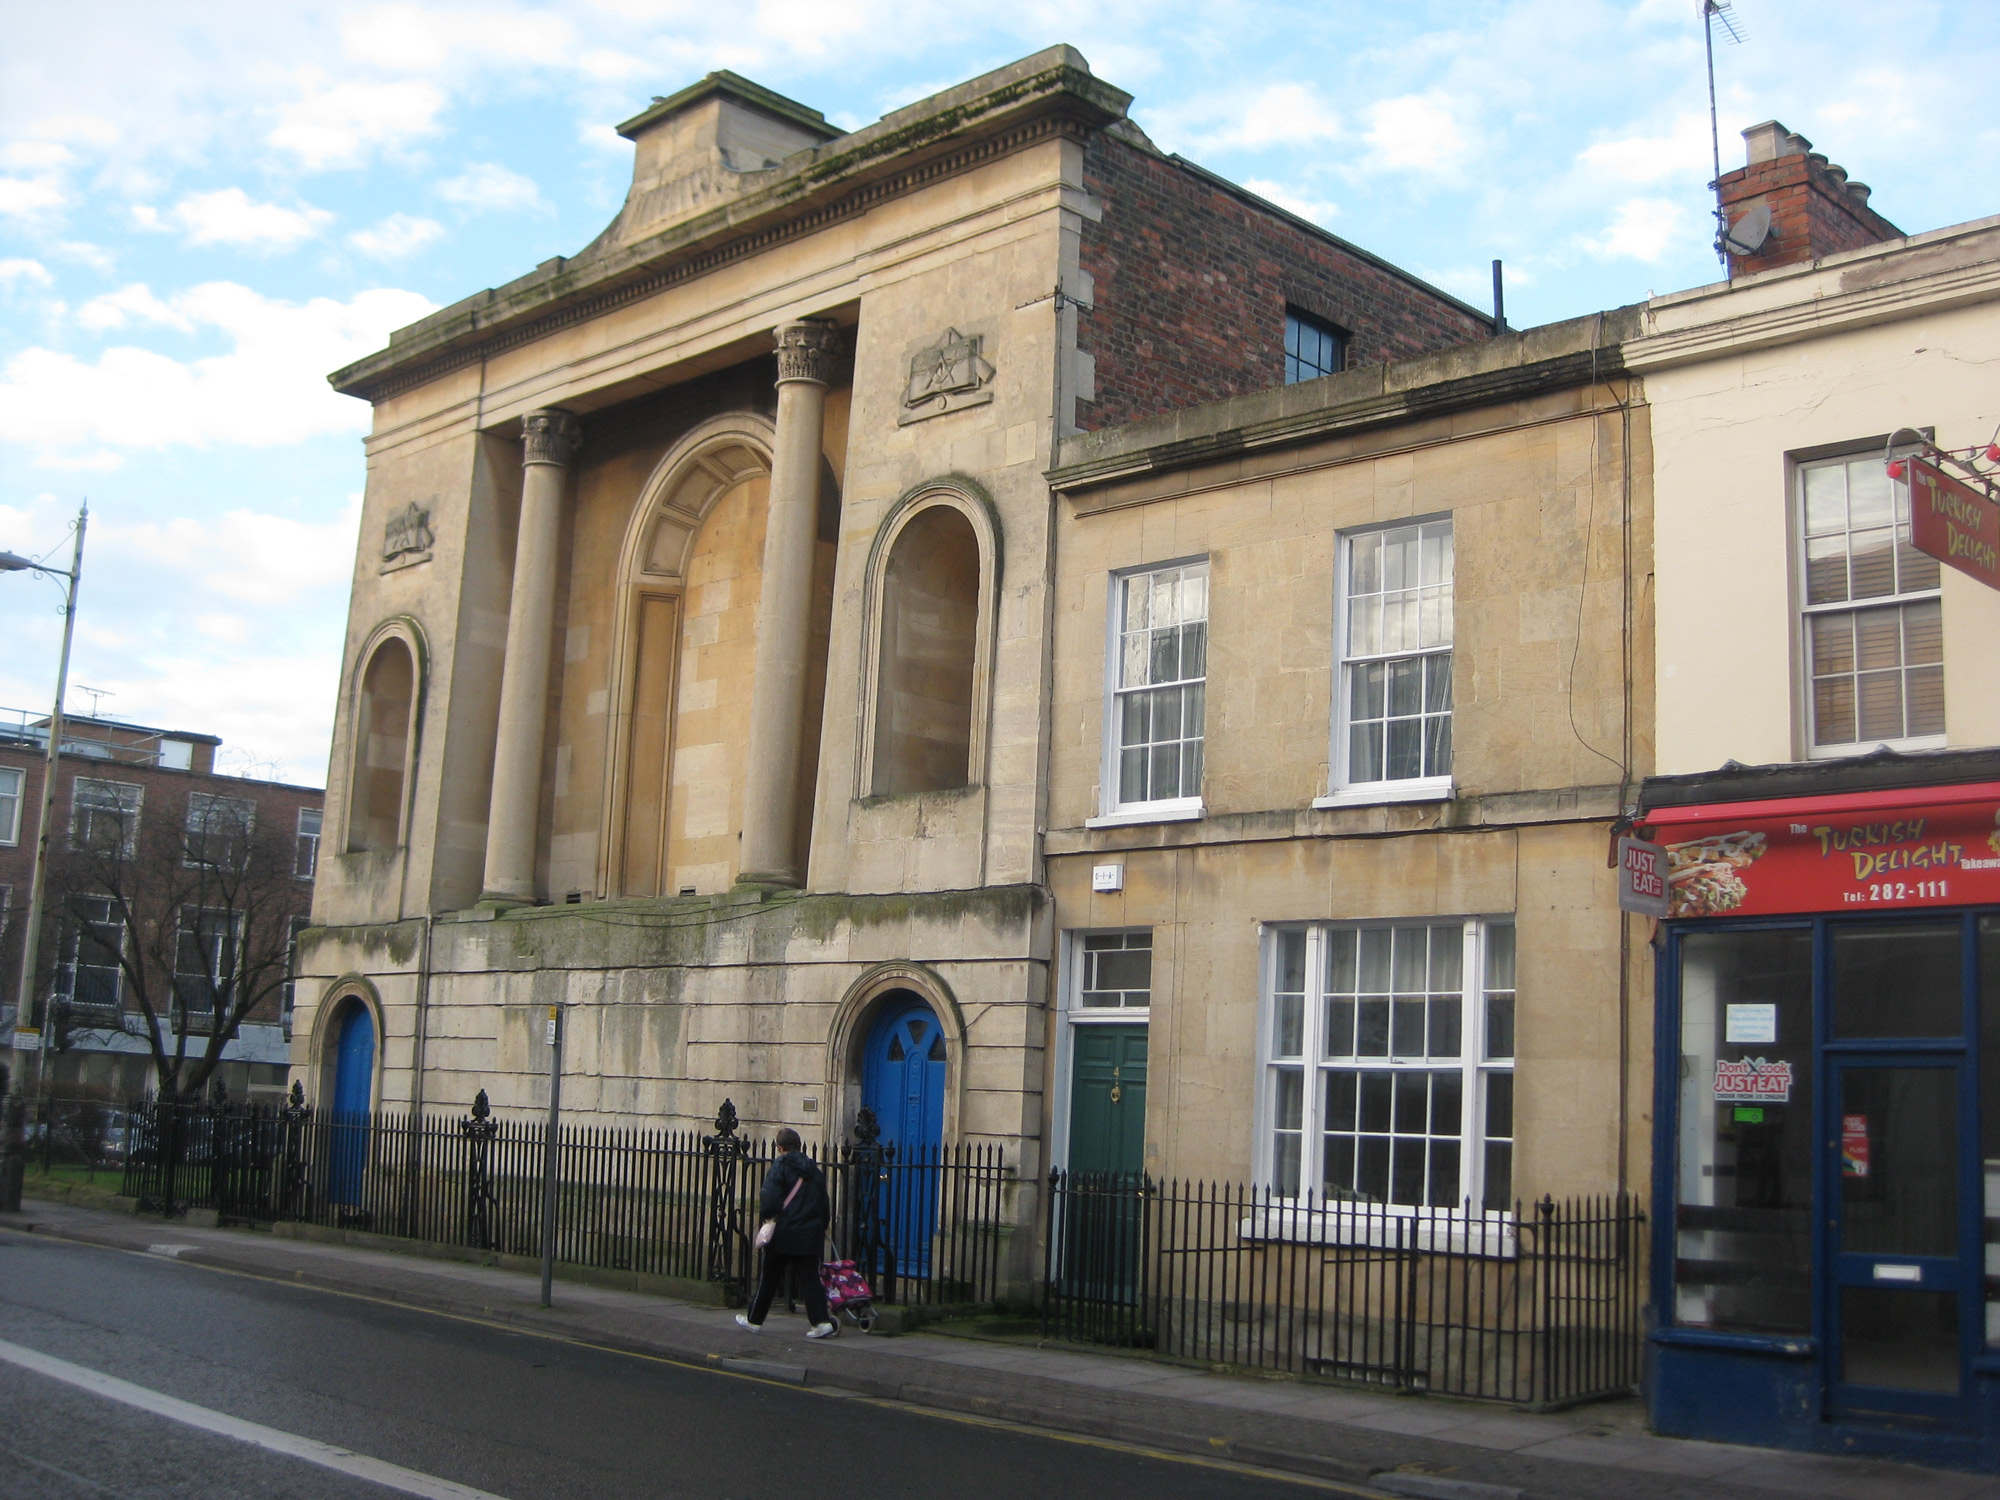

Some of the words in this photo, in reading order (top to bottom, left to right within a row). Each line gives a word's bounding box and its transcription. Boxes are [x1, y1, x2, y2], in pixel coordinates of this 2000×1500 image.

[1946, 520, 1996, 572] DELIGHT
[1790, 823, 1807, 834] The
[1812, 818, 1925, 857] TURKISH
[1626, 849, 1655, 873] JUST
[1850, 841, 1963, 880] DELIGHT
[1633, 871, 1655, 893] EAT
[1843, 892, 1866, 902] Tel:
[1869, 880, 1947, 901] 282-111
[1759, 1062, 1788, 1074] cook
[1716, 1075, 1755, 1092] JUST
[1757, 1075, 1789, 1092] EAT
